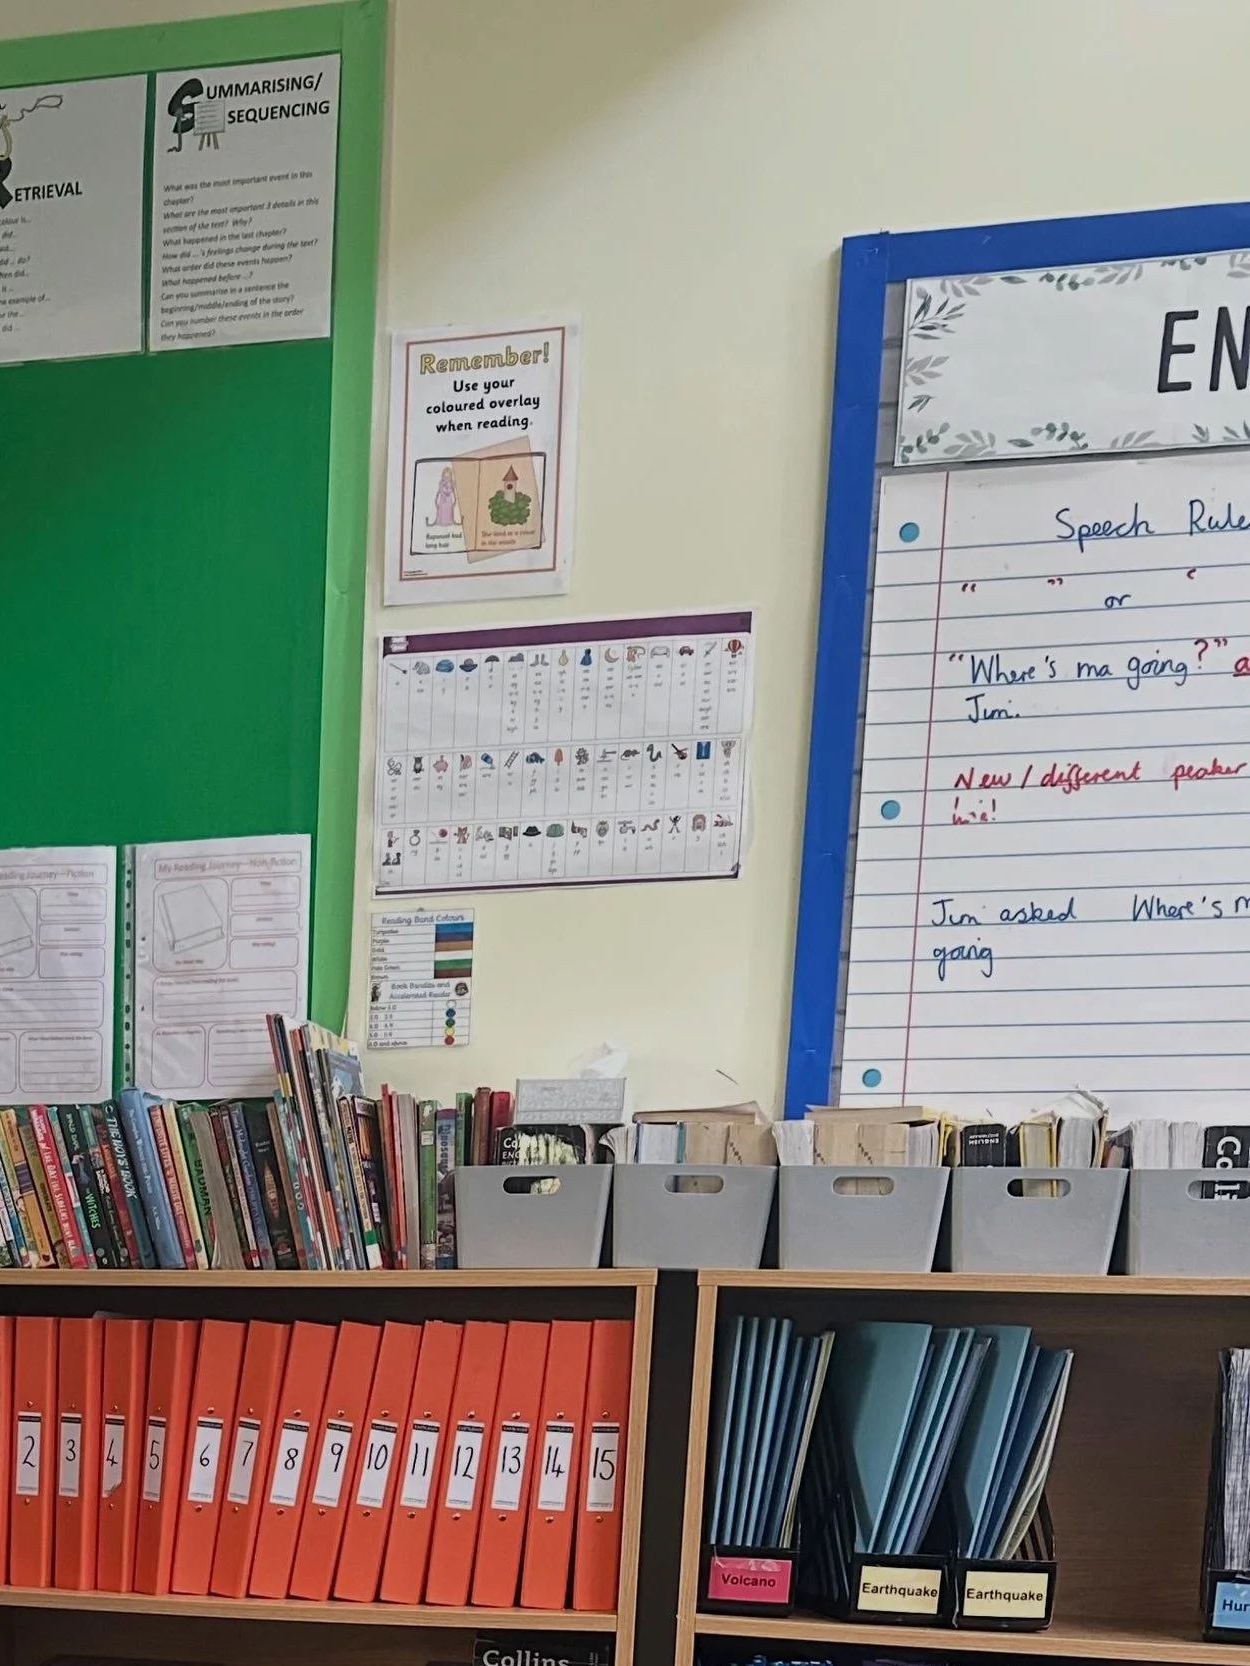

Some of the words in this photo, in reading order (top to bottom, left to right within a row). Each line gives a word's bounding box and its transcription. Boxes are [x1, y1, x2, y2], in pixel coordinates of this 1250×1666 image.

[227, 99, 331, 125] SEQUENCING
[419, 341, 550, 375] Remember!
[453, 380, 479, 392] Use
[483, 378, 515, 394] your
[426, 398, 485, 414] coloured
[489, 394, 540, 412] overlay
[436, 420, 473, 433] when
[1055, 502, 1154, 553] Speech
[1104, 593, 1132, 610] or
[1076, 658, 1113, 679] ma
[954, 767, 1012, 790] New
[1040, 762, 1142, 793] different
[932, 898, 982, 927] Jim
[1000, 897, 1077, 923] asked
[1132, 894, 1223, 922] Where's
[933, 937, 993, 981] going
[120, 1168, 138, 1200] BOOK
[85, 1193, 101, 1229] WITCHES
[21, 1435, 36, 1468] 2
[65, 1439, 77, 1462] 3
[106, 1438, 119, 1466] 4
[149, 1440, 161, 1470] 5
[199, 1443, 210, 1467] 6
[242, 1440, 254, 1467] 7
[284, 1447, 299, 1471] 8
[330, 1443, 344, 1473] 9
[366, 1442, 389, 1471] 10
[411, 1442, 430, 1477] 11
[453, 1444, 475, 1480] 12
[500, 1444, 521, 1475] 13
[544, 1444, 566, 1478] 14
[592, 1447, 616, 1481] 15
[720, 1573, 777, 1589] Volcano
[861, 1581, 939, 1600] Earthquake
[965, 1586, 1044, 1603] Earthquake
